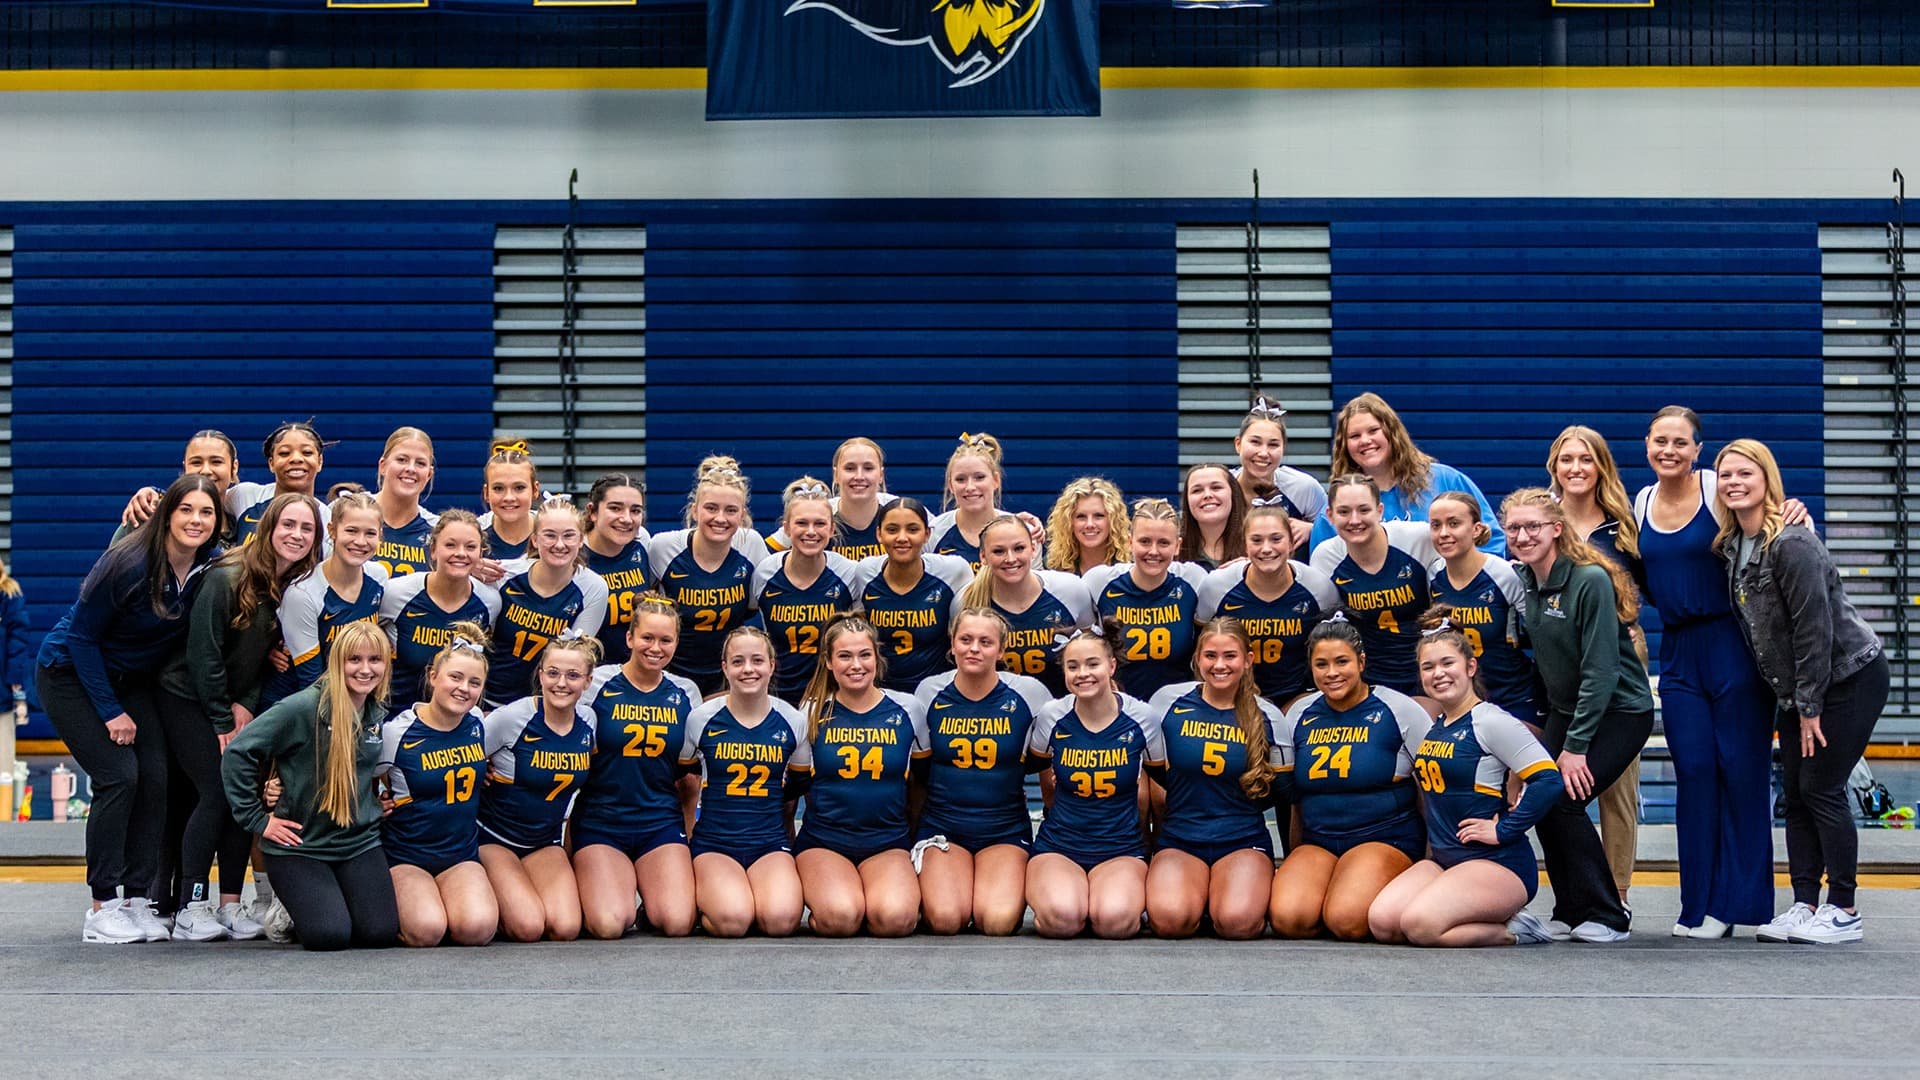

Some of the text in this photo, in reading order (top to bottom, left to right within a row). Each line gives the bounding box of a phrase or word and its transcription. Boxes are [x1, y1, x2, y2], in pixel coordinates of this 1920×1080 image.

[373, 541, 426, 564] GUSTANA
[832, 544, 886, 562] AUGUSTAN
[602, 567, 645, 590] USTANA
[678, 584, 745, 606] AUGUSTANA
[1348, 584, 1415, 611] AUGUSTANA
[608, 591, 635, 625] 19
[694, 608, 731, 631] 21
[770, 603, 836, 622] AUGUSTANA
[870, 608, 937, 628] AUGUSTANA
[1115, 604, 1181, 625] AUGUSTANA
[1450, 606, 1493, 625] STANA
[1240, 618, 1302, 637] UGUSTANA
[1377, 610, 1400, 634] 4
[412, 625, 460, 647] AUGUST
[512, 630, 549, 662] 17
[785, 625, 819, 654] 12
[892, 630, 913, 655] 3
[1004, 628, 1055, 648] USTANA
[1126, 627, 1171, 661] 28
[1250, 638, 1284, 664] 18
[611, 703, 677, 725] AUGUSTANA
[939, 717, 1011, 735] AUGUSTANA
[623, 723, 668, 757] 25
[825, 728, 896, 745] AUGUSTANA
[1180, 719, 1247, 744] AUGUSTAN
[1307, 726, 1368, 745] AUGUSTANA
[421, 742, 484, 771] AUGUSTANA
[530, 750, 590, 771] AUGUSTANA
[715, 742, 783, 763] AUGUSTANA
[837, 746, 883, 780] 34
[949, 738, 997, 770] 39
[1061, 747, 1128, 768] AUGUSTANA
[1202, 741, 1228, 776] 5
[1309, 745, 1351, 780] 24
[444, 767, 476, 805] 13
[545, 773, 574, 801] 7
[726, 763, 770, 797] 22
[1070, 770, 1117, 799] 35
[1415, 758, 1446, 794] 38
